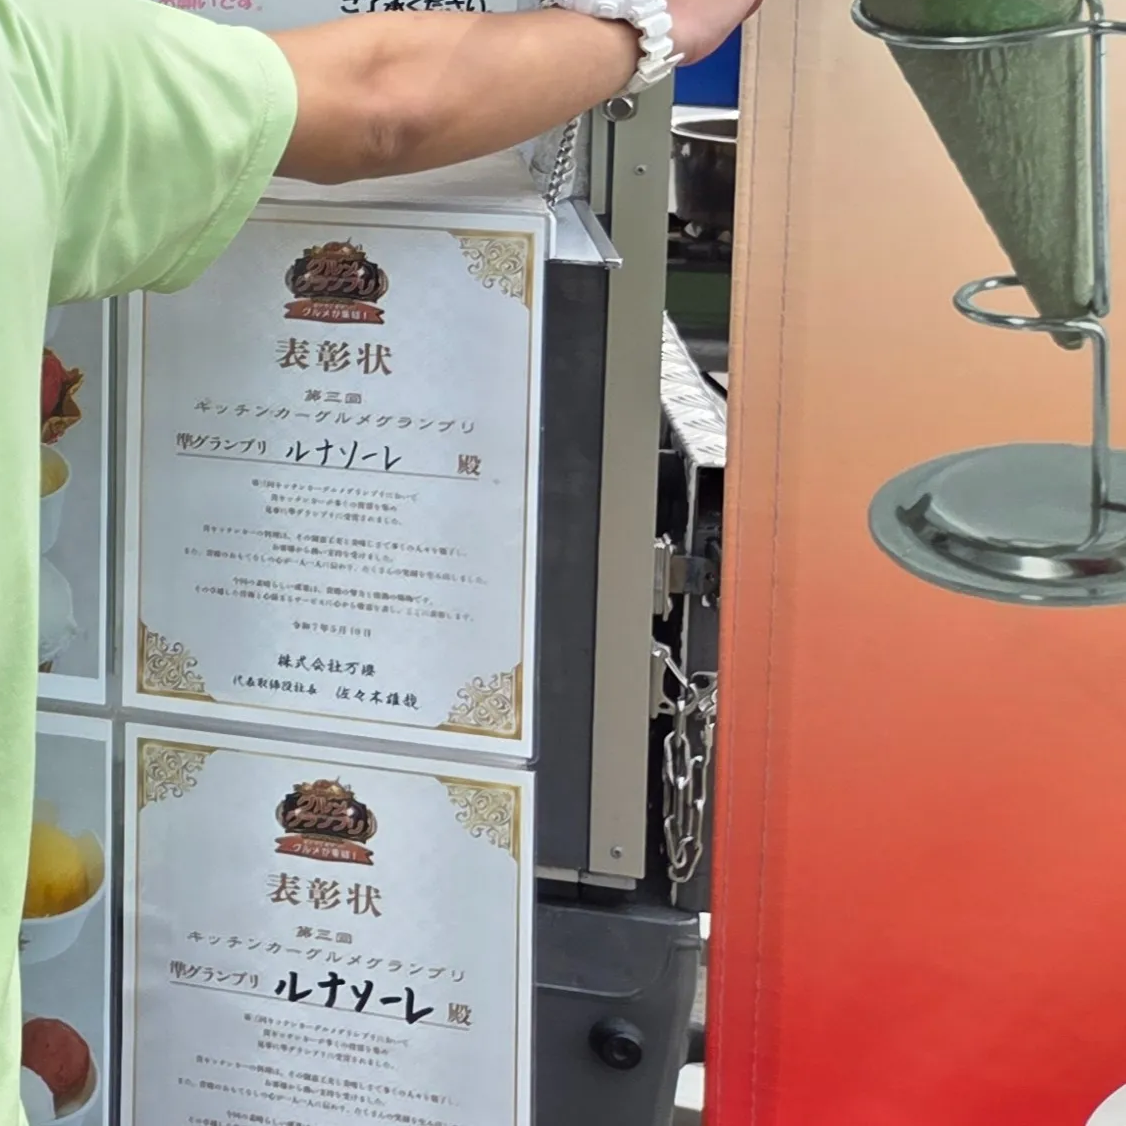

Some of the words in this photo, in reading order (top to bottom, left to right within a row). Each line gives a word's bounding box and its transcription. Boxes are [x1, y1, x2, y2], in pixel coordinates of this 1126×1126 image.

[275, 337, 393, 375] 表彰状
[304, 388, 363, 405] 第三回
[193, 399, 475, 435] キッチンカーグルメグランプリ
[176, 432, 268, 456] 準グランプリ
[457, 453, 481, 475] 殿
[267, 872, 383, 919] 表彰状
[186, 930, 466, 983] キッチンカーグルメグランプリ
[169, 960, 260, 990] 準グランプリ
[447, 1002, 473, 1027] 殿
